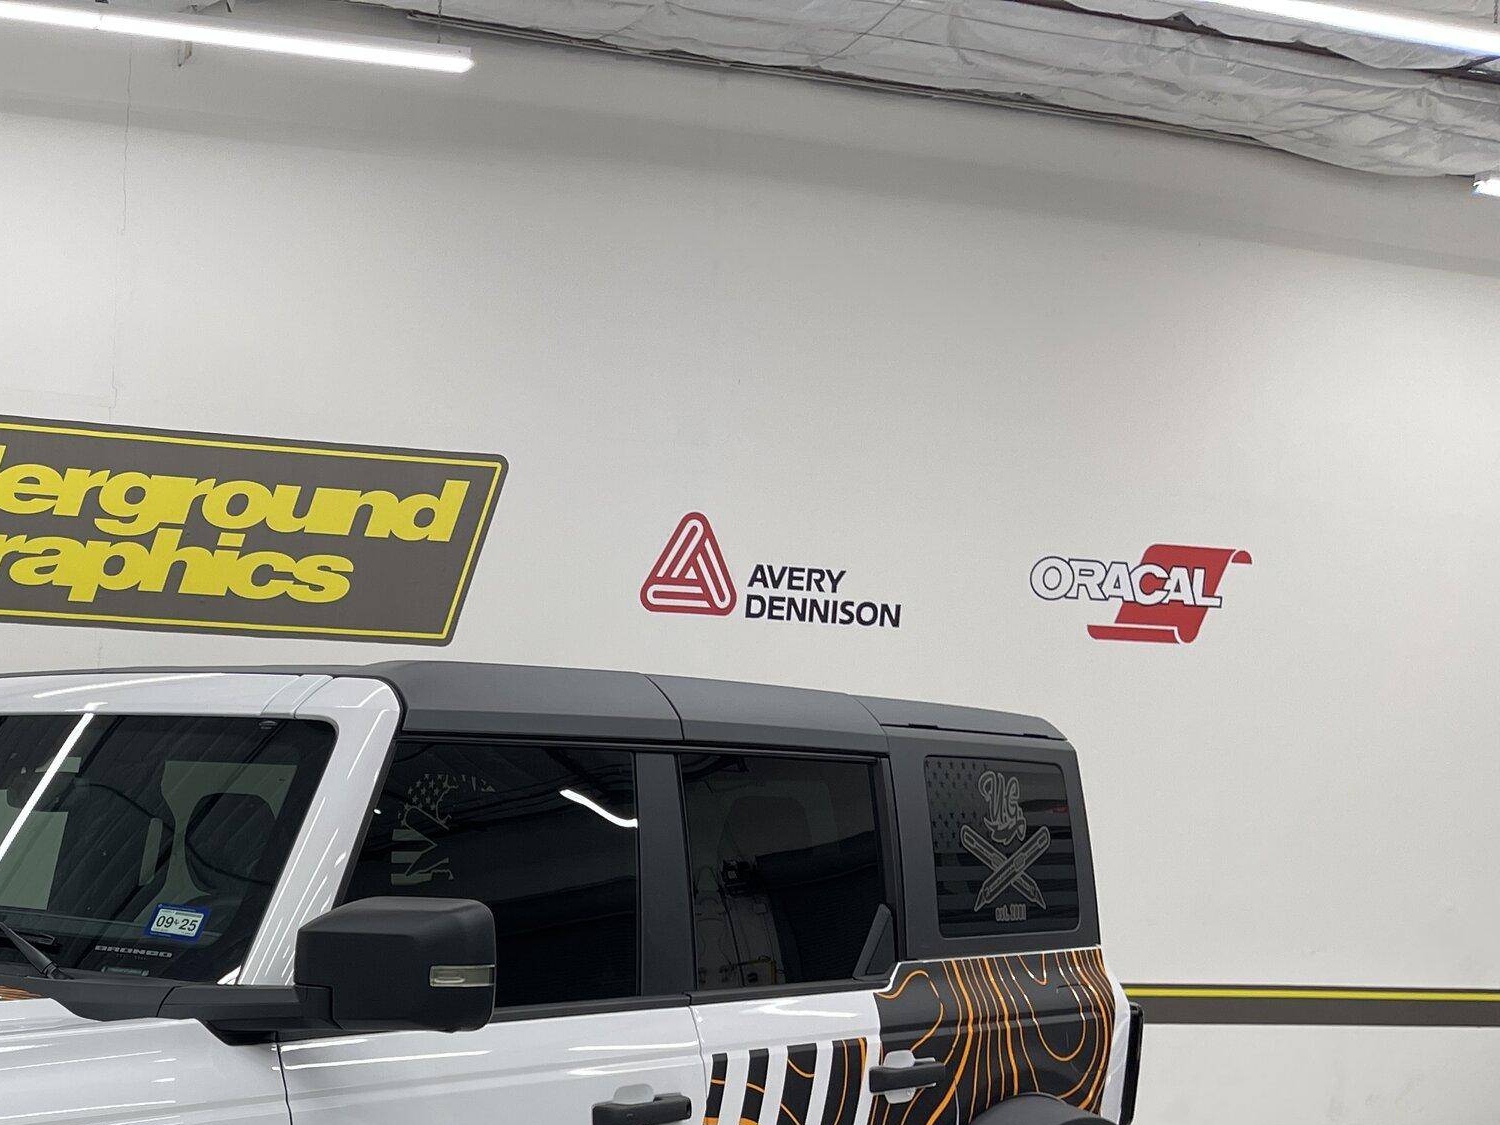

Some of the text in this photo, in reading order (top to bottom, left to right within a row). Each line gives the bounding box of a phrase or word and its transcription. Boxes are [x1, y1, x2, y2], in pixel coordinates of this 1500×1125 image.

[747, 564, 847, 594] AVERY
[1030, 556, 1223, 608] ORACAL
[744, 593, 902, 628] DENNISON
[156, 915, 198, 932] 09 25
